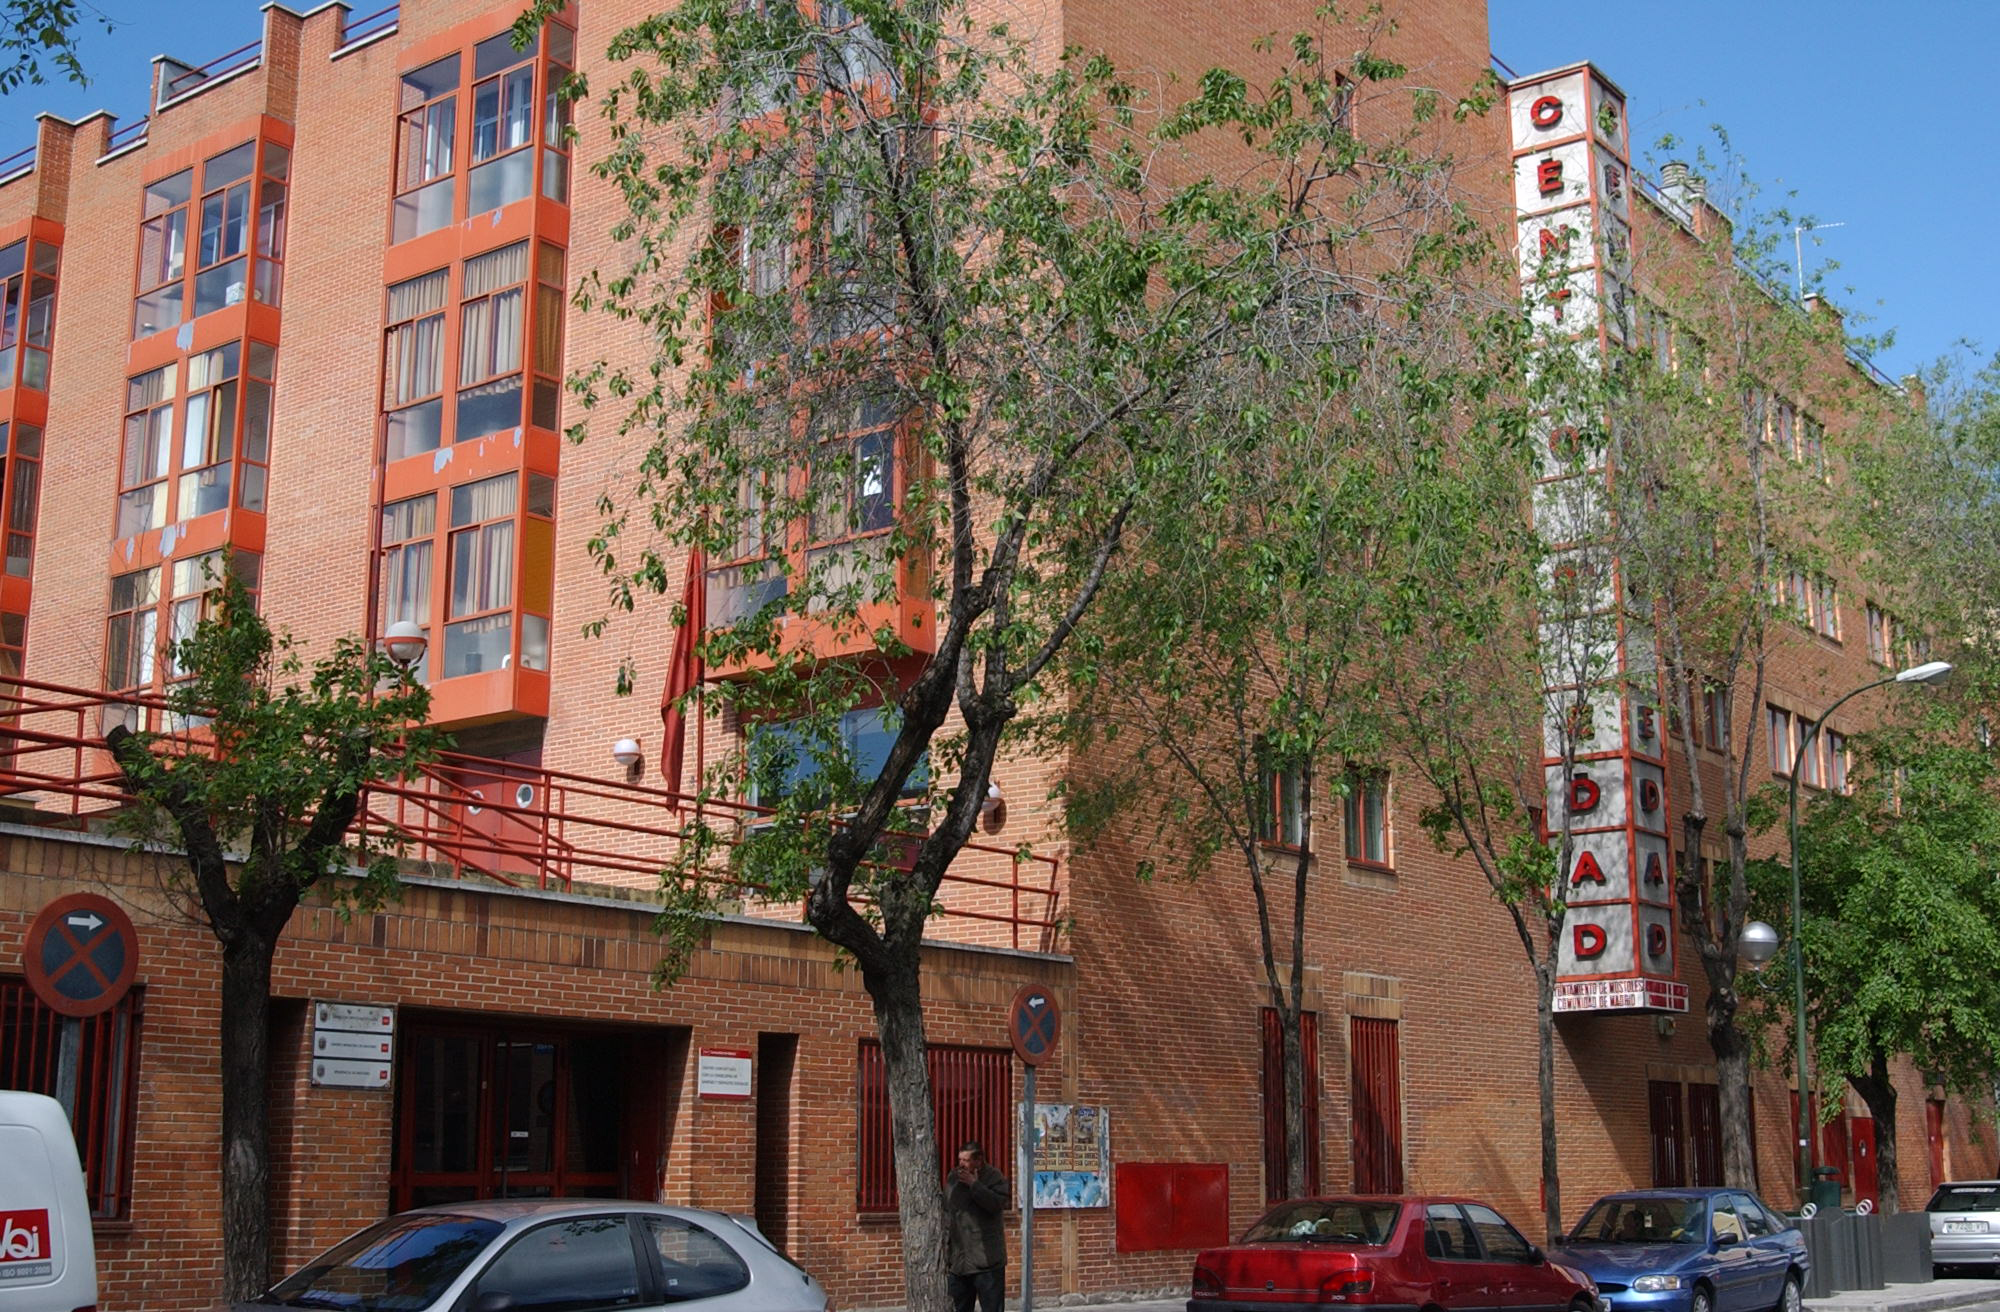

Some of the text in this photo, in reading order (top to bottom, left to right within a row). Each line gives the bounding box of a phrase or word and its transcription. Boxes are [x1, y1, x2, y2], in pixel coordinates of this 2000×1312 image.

[1531, 95, 1580, 462] CENTO
[1637, 706, 1668, 956] EDAD
[1555, 982, 1597, 996] UNTAMIENTO
[1600, 981, 1607, 994] DE
[1600, 995, 1607, 1008] DE
